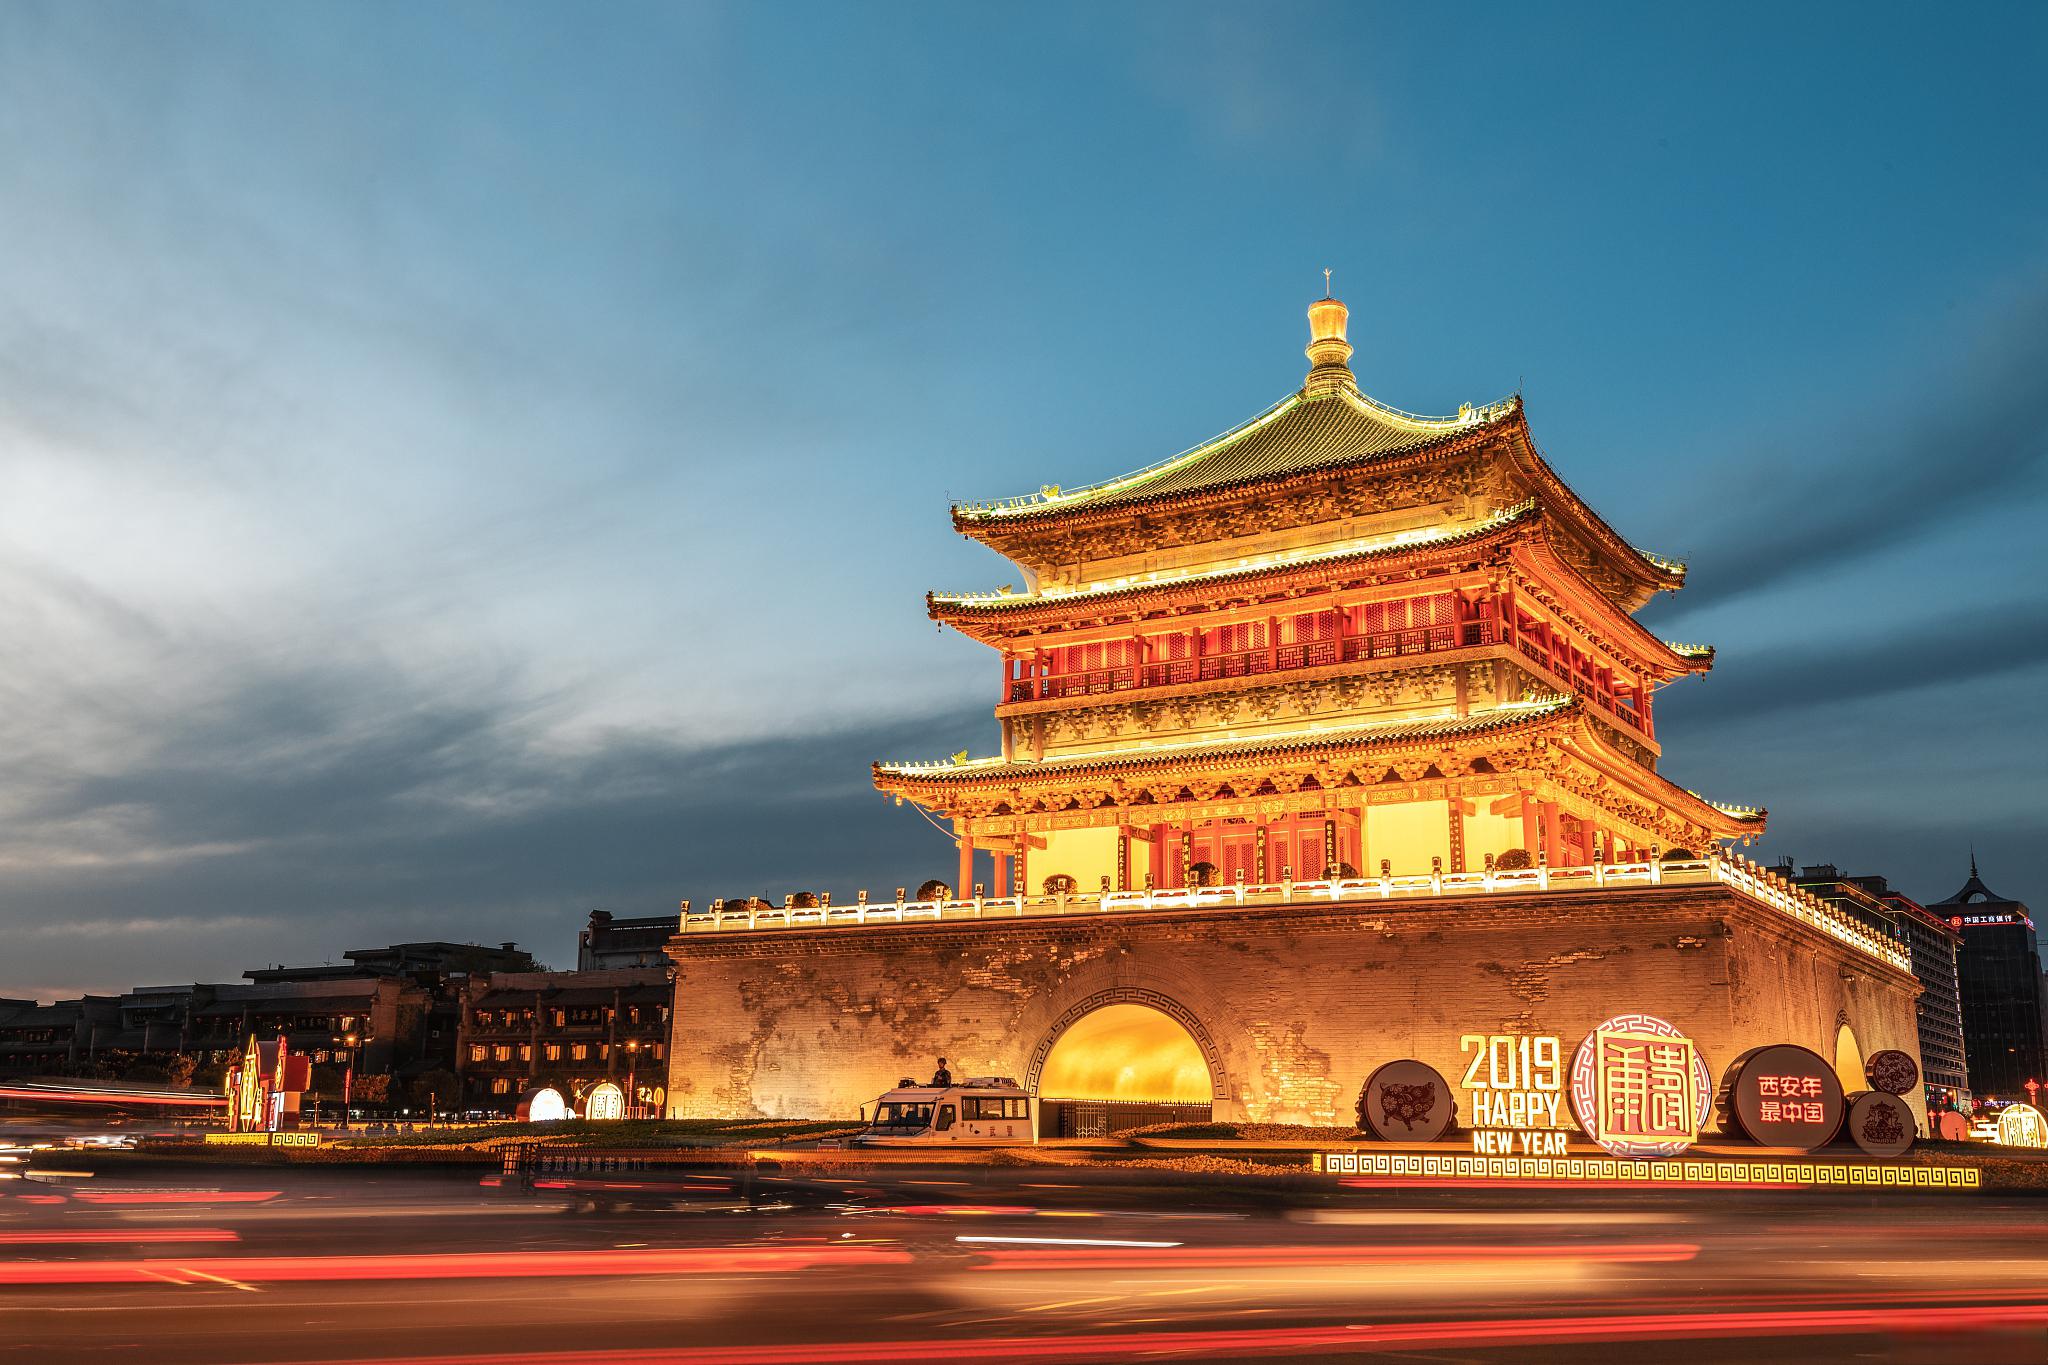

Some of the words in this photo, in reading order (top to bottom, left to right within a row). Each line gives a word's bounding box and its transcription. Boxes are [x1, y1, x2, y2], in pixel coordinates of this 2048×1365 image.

[1460, 1035, 1561, 1090] 2019
[1758, 1075, 1823, 1098] 西安年
[1472, 1091, 1561, 1127] HAPPY
[1760, 1101, 1825, 1123] 最中国
[1473, 1131, 1513, 1154] NEW
[1520, 1132, 1568, 1156] YEAR
